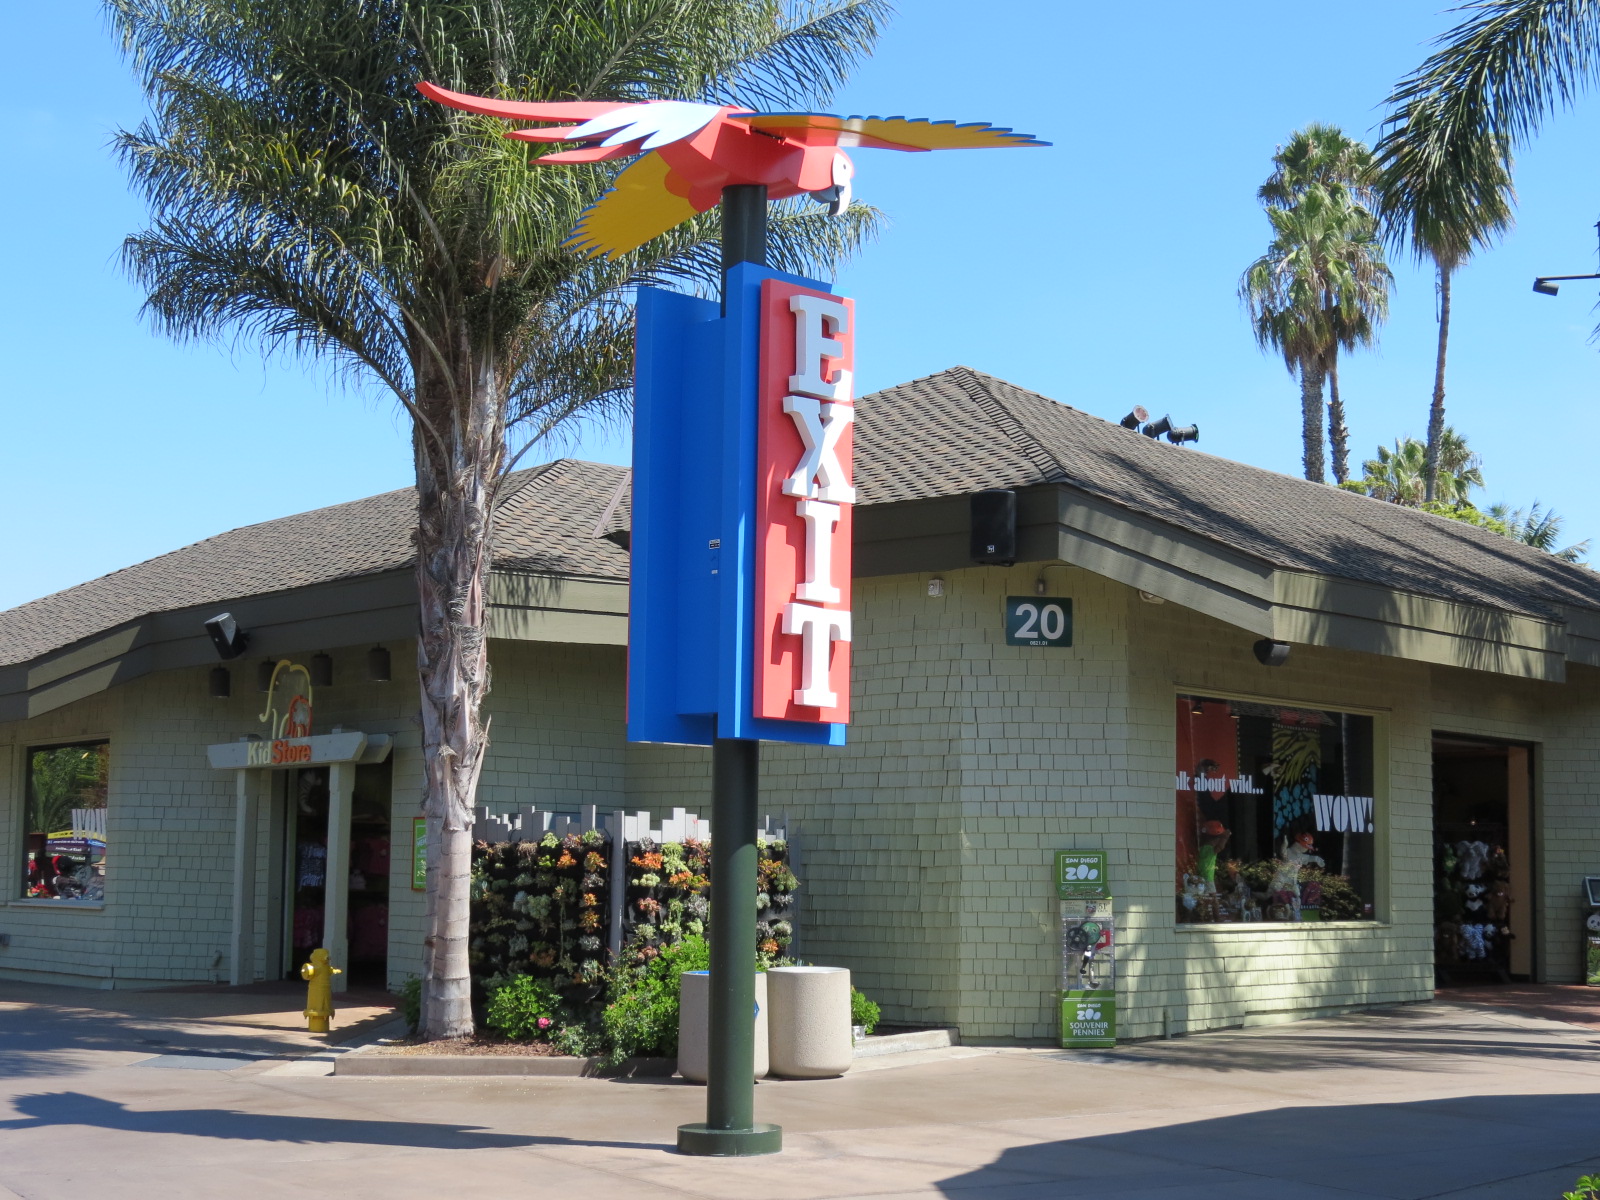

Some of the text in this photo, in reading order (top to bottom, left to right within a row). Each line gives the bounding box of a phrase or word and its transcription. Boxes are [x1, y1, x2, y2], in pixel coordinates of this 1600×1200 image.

[783, 295, 855, 707] EXIT
[1014, 603, 1064, 639] 20
[1193, 772, 1226, 792] about
[1312, 794, 1374, 833] WOW!
[1069, 1021, 1109, 1029] SOUVENIR
